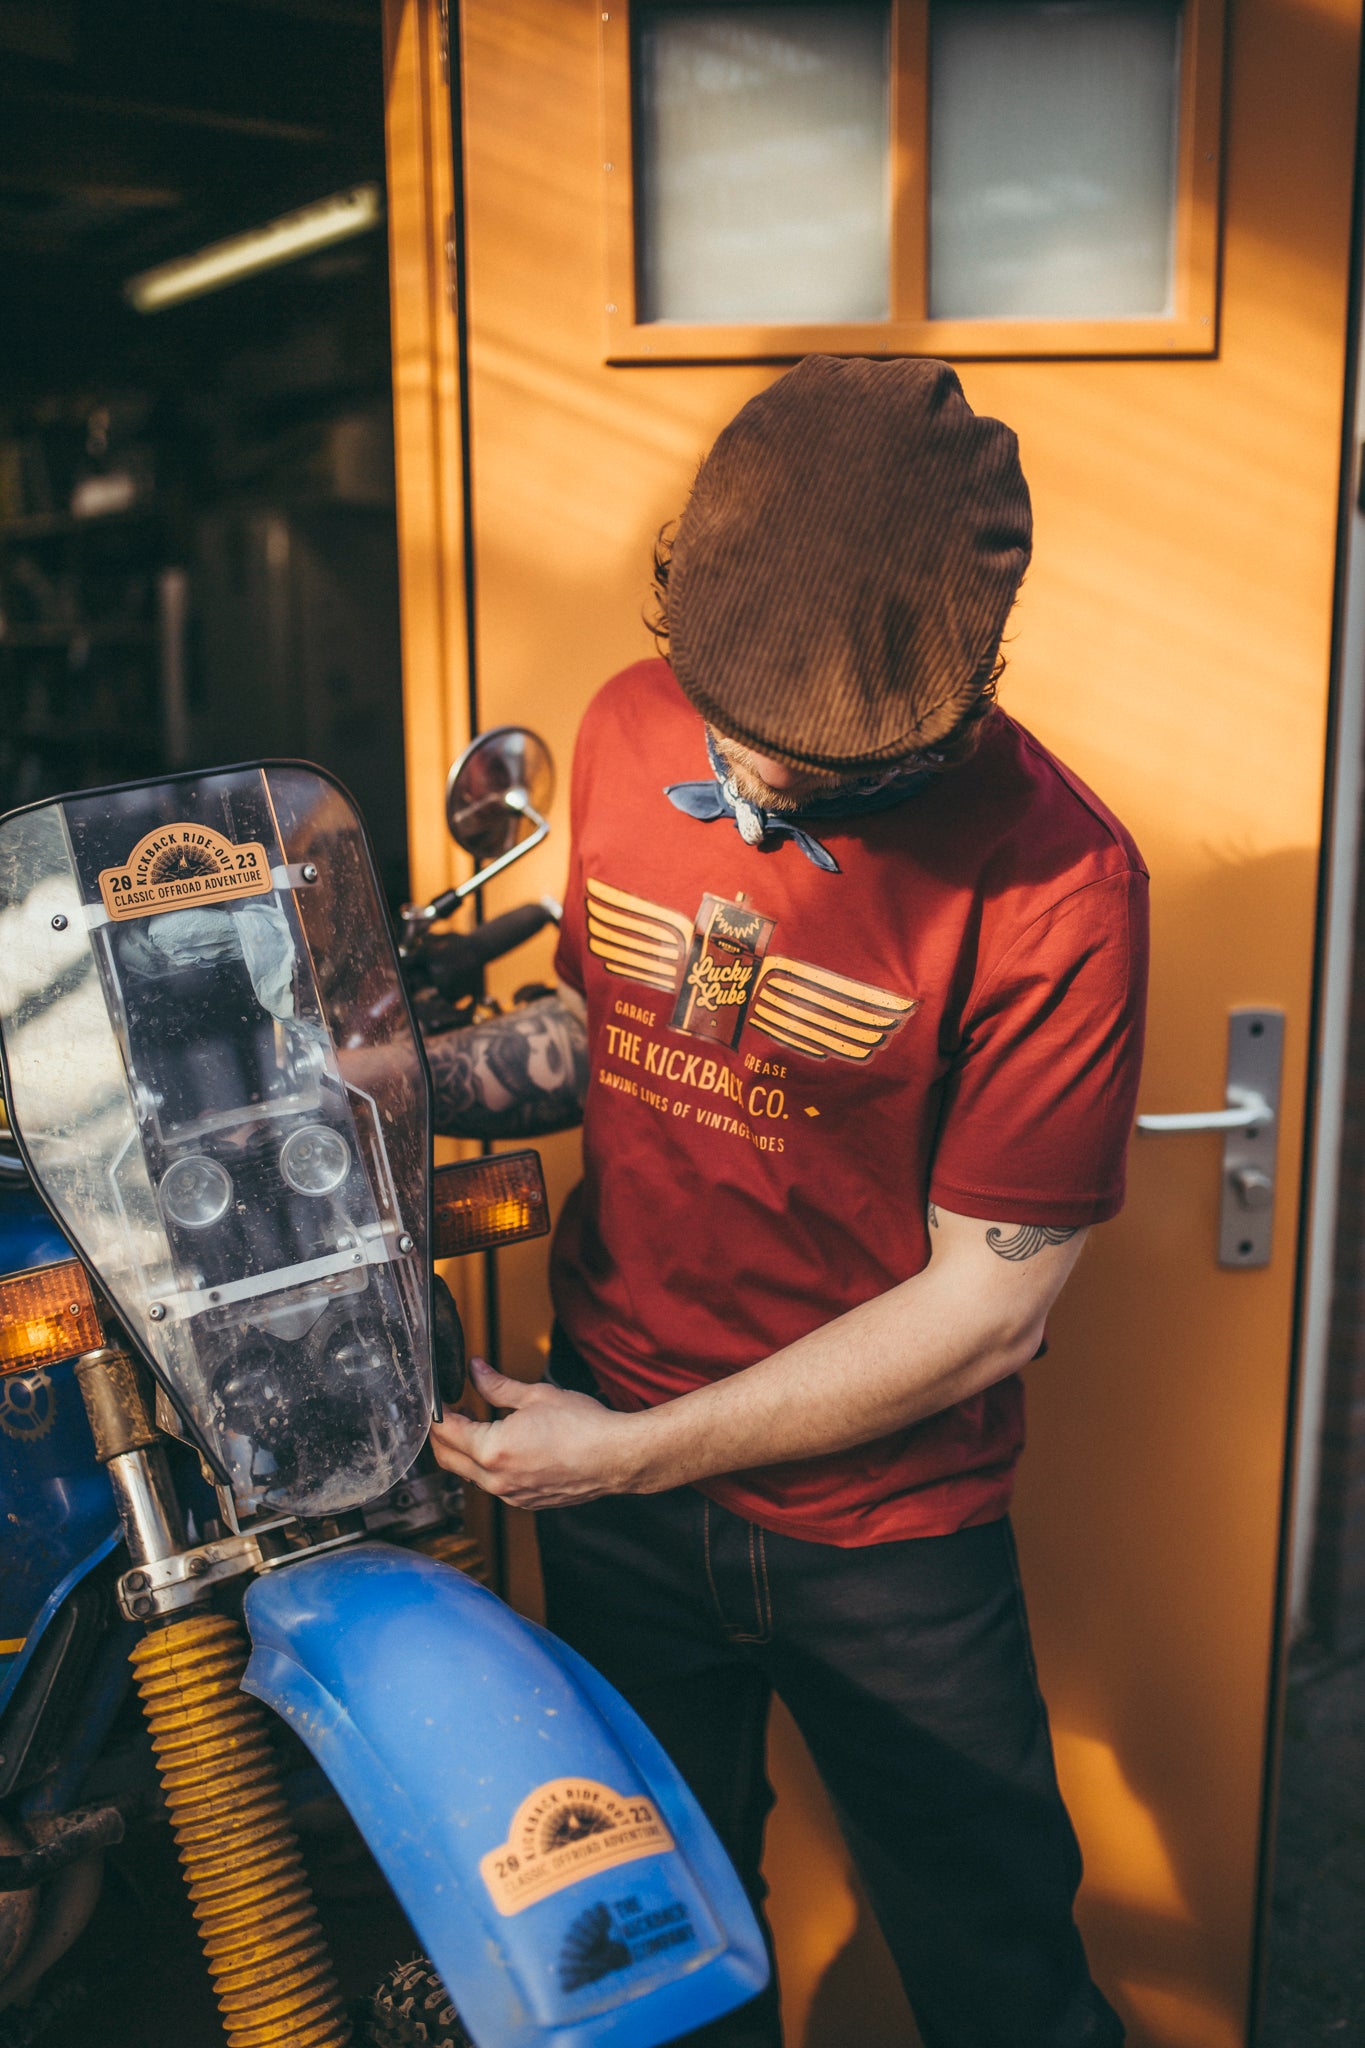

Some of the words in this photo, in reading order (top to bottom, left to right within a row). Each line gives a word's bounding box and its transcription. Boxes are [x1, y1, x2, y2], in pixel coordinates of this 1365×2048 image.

[136, 833, 177, 886] KICKBACK
[183, 832, 234, 871] RIDE-OUT
[235, 852, 257, 869] 23
[110, 875, 132, 893] 20
[114, 889, 156, 907] CLASSIC
[157, 882, 202, 899] OFFROAD
[204, 869, 262, 890] ADVENTURE
[687, 955, 754, 988] Lucky
[695, 981, 747, 1010] Lube
[614, 1000, 656, 1027] GARAGE
[605, 1025, 641, 1066] THE
[748, 1086, 790, 1120] CO.
[744, 1053, 788, 1079] GREASE
[599, 1069, 639, 1097] SAVING
[640, 1087, 669, 1112] LIVES
[672, 1100, 692, 1118] OF
[696, 1108, 750, 1140] VINTAGE
[629, 1806, 652, 1824] 23
[604, 1826, 661, 1848] ADVENTURE
